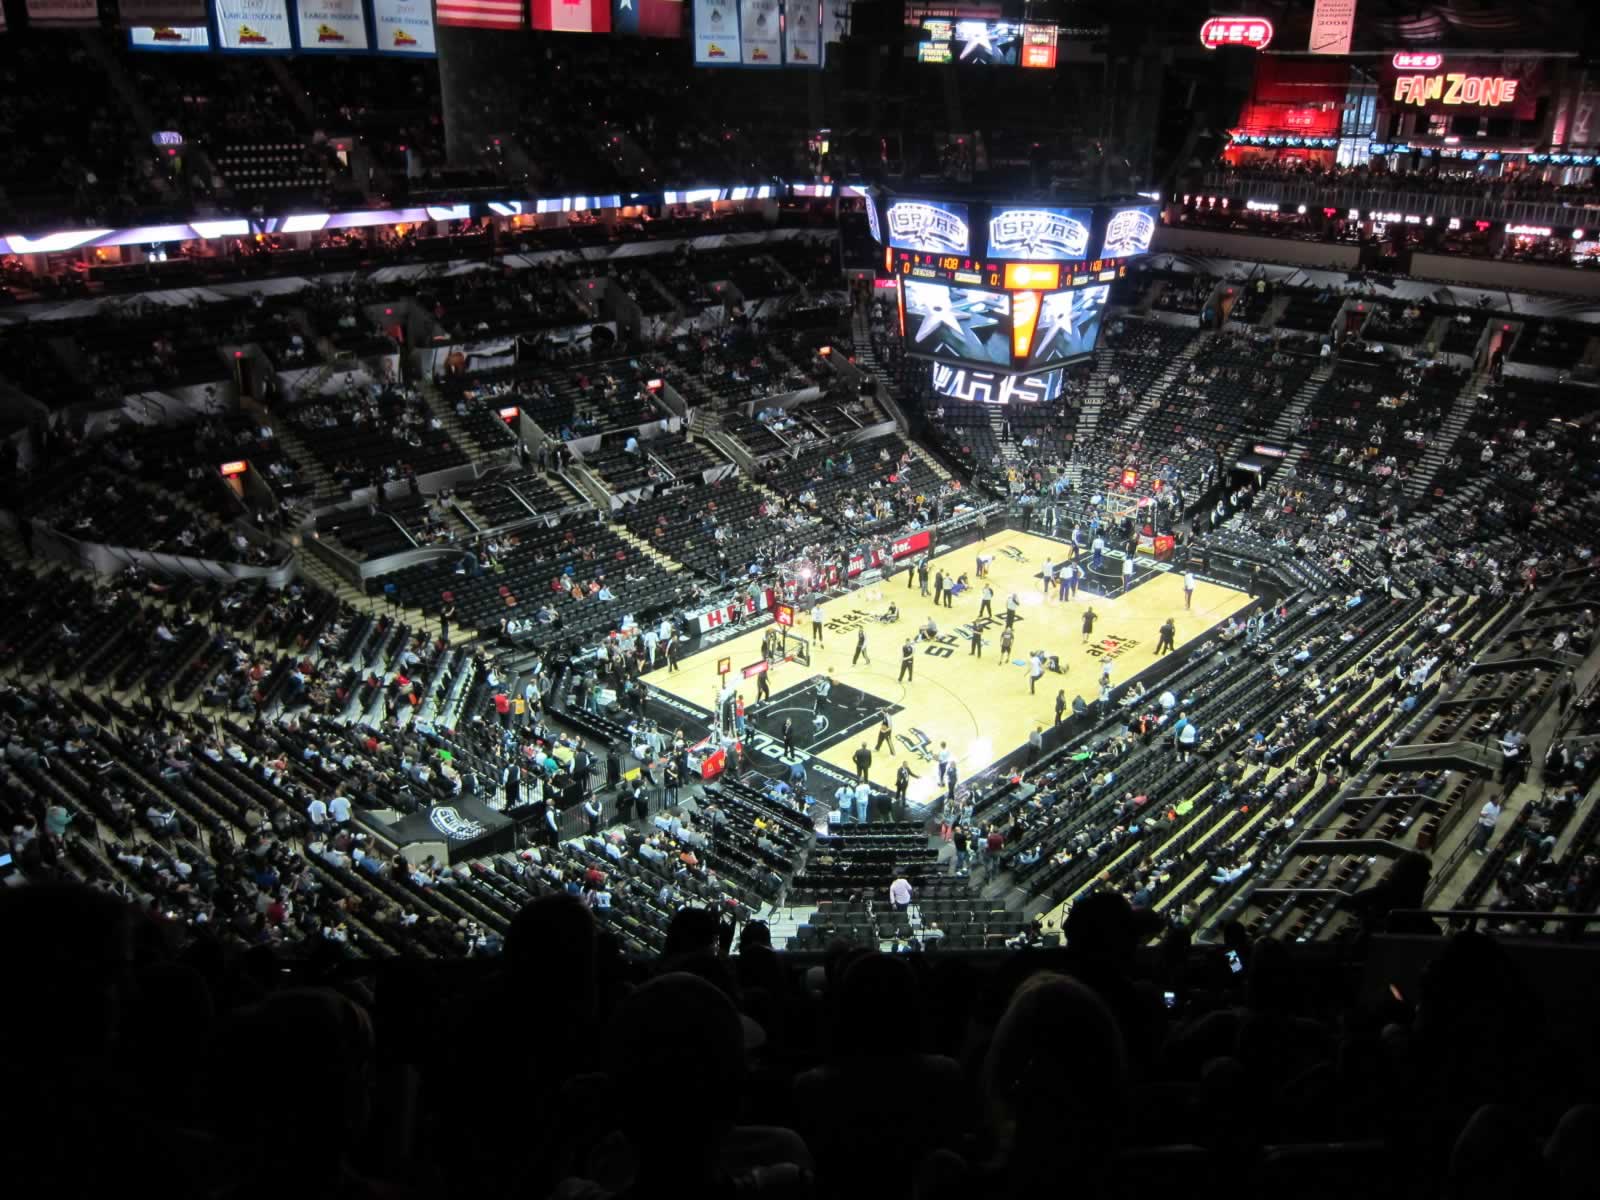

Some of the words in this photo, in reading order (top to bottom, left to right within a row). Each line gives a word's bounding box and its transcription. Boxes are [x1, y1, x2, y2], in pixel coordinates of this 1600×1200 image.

[1208, 26, 1265, 41] H-E-B
[1394, 75, 1443, 106] FAN
[1443, 73, 1518, 106] ZONE
[897, 212, 961, 237] SPURS
[1003, 219, 1080, 240] SPURS
[1505, 223, 1551, 236] Lakers
[1096, 547, 1174, 571] SPRS
[1086, 634, 1128, 657] at&t
[1106, 639, 1141, 659] ENTER
[812, 764, 858, 787] NTONIO
